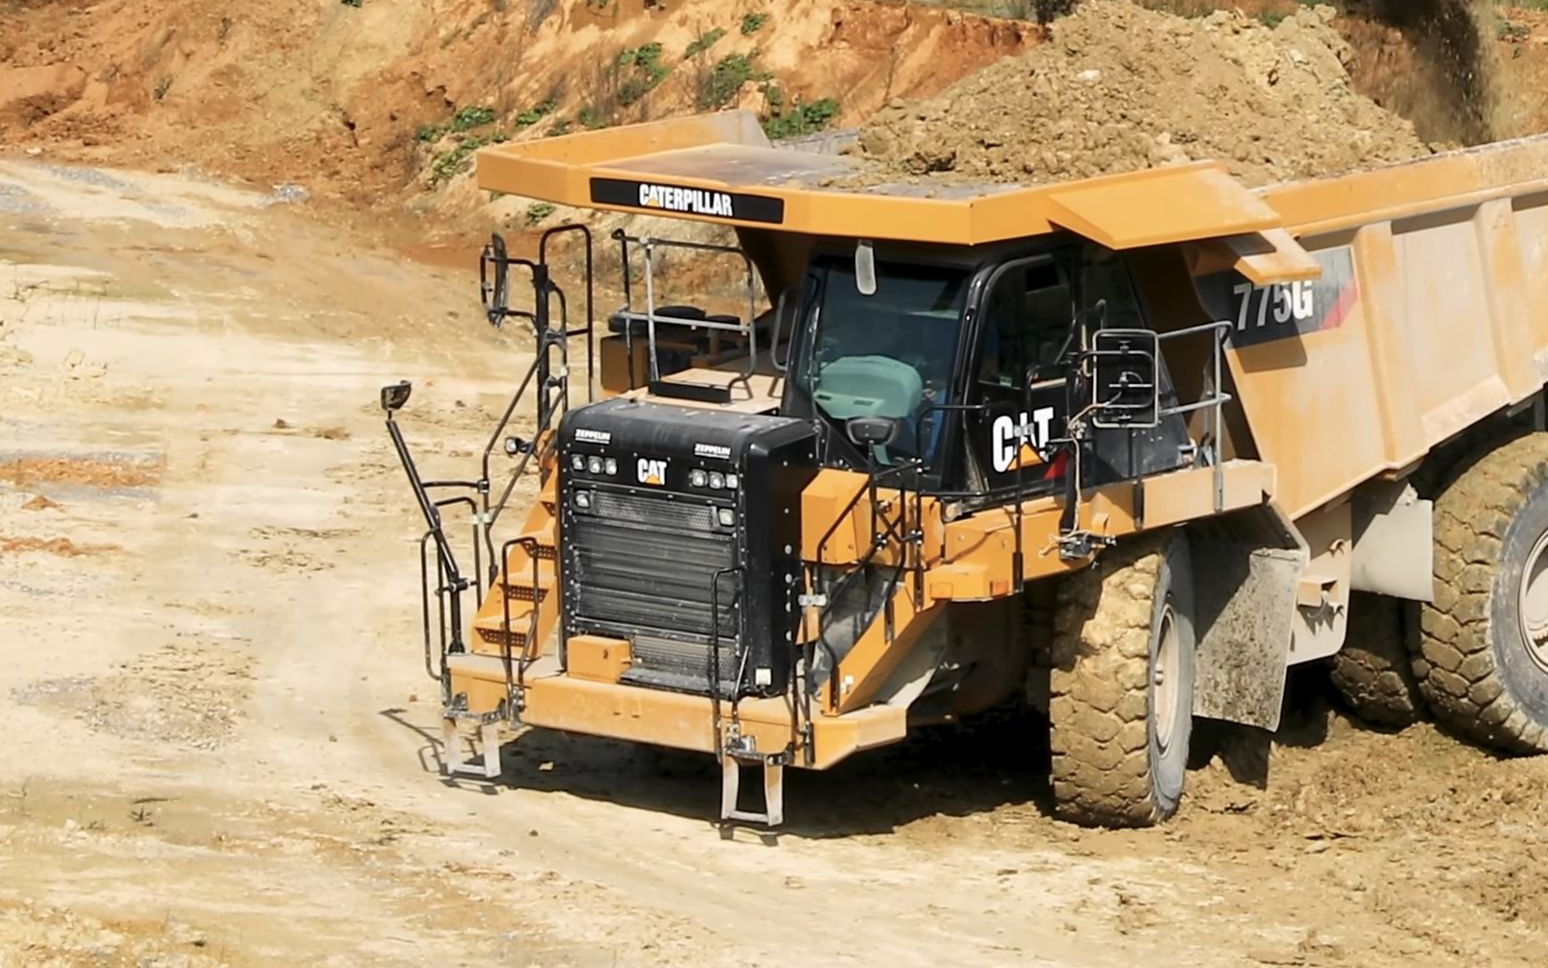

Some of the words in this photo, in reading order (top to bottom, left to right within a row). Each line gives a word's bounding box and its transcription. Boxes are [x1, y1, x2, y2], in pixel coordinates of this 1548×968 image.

[639, 184, 733, 217] CATERPILLAR
[1233, 279, 1314, 331] 775G
[575, 428, 611, 441] ZEPPELIN
[694, 443, 731, 456] ZEPPELIN
[637, 458, 667, 486] CAT
